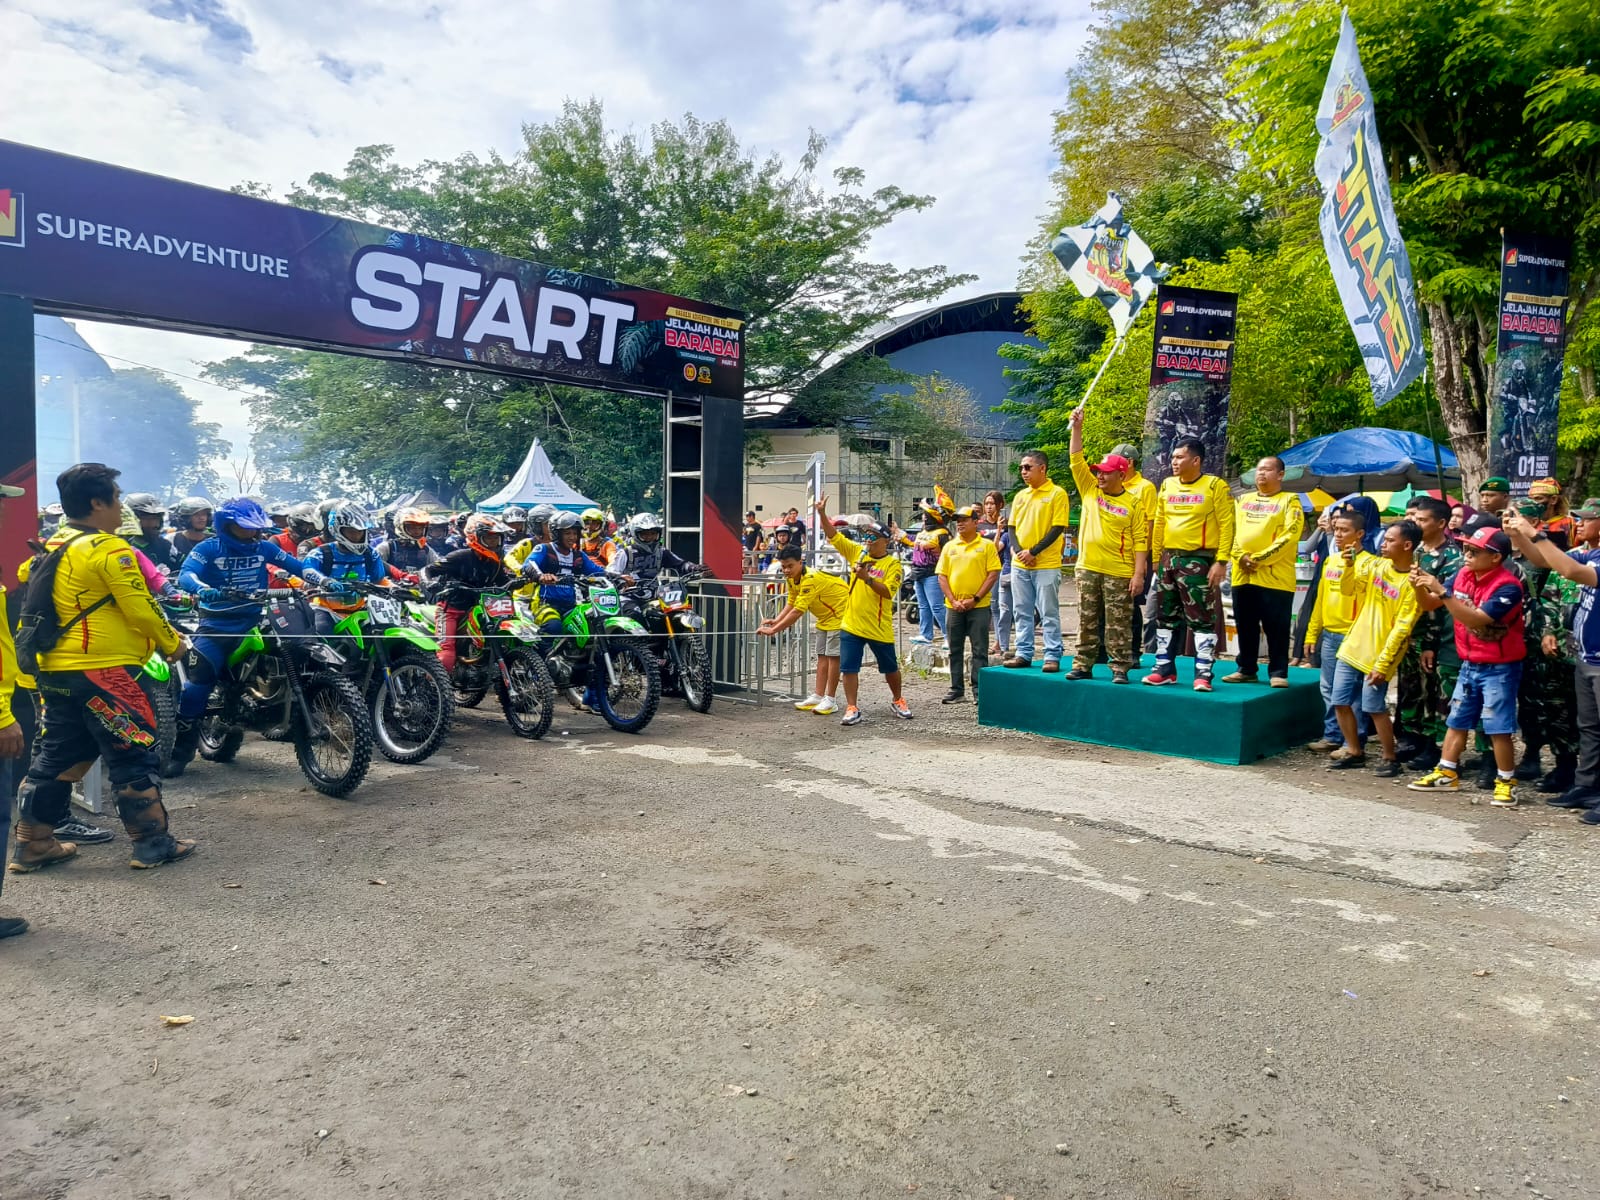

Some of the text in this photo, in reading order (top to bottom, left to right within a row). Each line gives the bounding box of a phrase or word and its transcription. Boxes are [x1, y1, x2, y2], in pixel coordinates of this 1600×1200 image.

[36, 213, 289, 278] SUPERADVENTURE
[351, 251, 635, 365] START
[1176, 305, 1232, 318] SUPERADVENTURE
[1502, 302, 1561, 317] JELAJAH ALAM
[665, 318, 711, 335] JELAJAH
[712, 326, 739, 341] ALAM
[1501, 313, 1560, 335] BARABAI
[665, 327, 740, 359] BARABAI
[1158, 345, 1227, 358] JELAJAH ALAM
[1156, 353, 1227, 374] BARABAI
[1518, 455, 1535, 477] 01
[1535, 461, 1549, 470] NOV
[489, 599, 513, 613] 42
